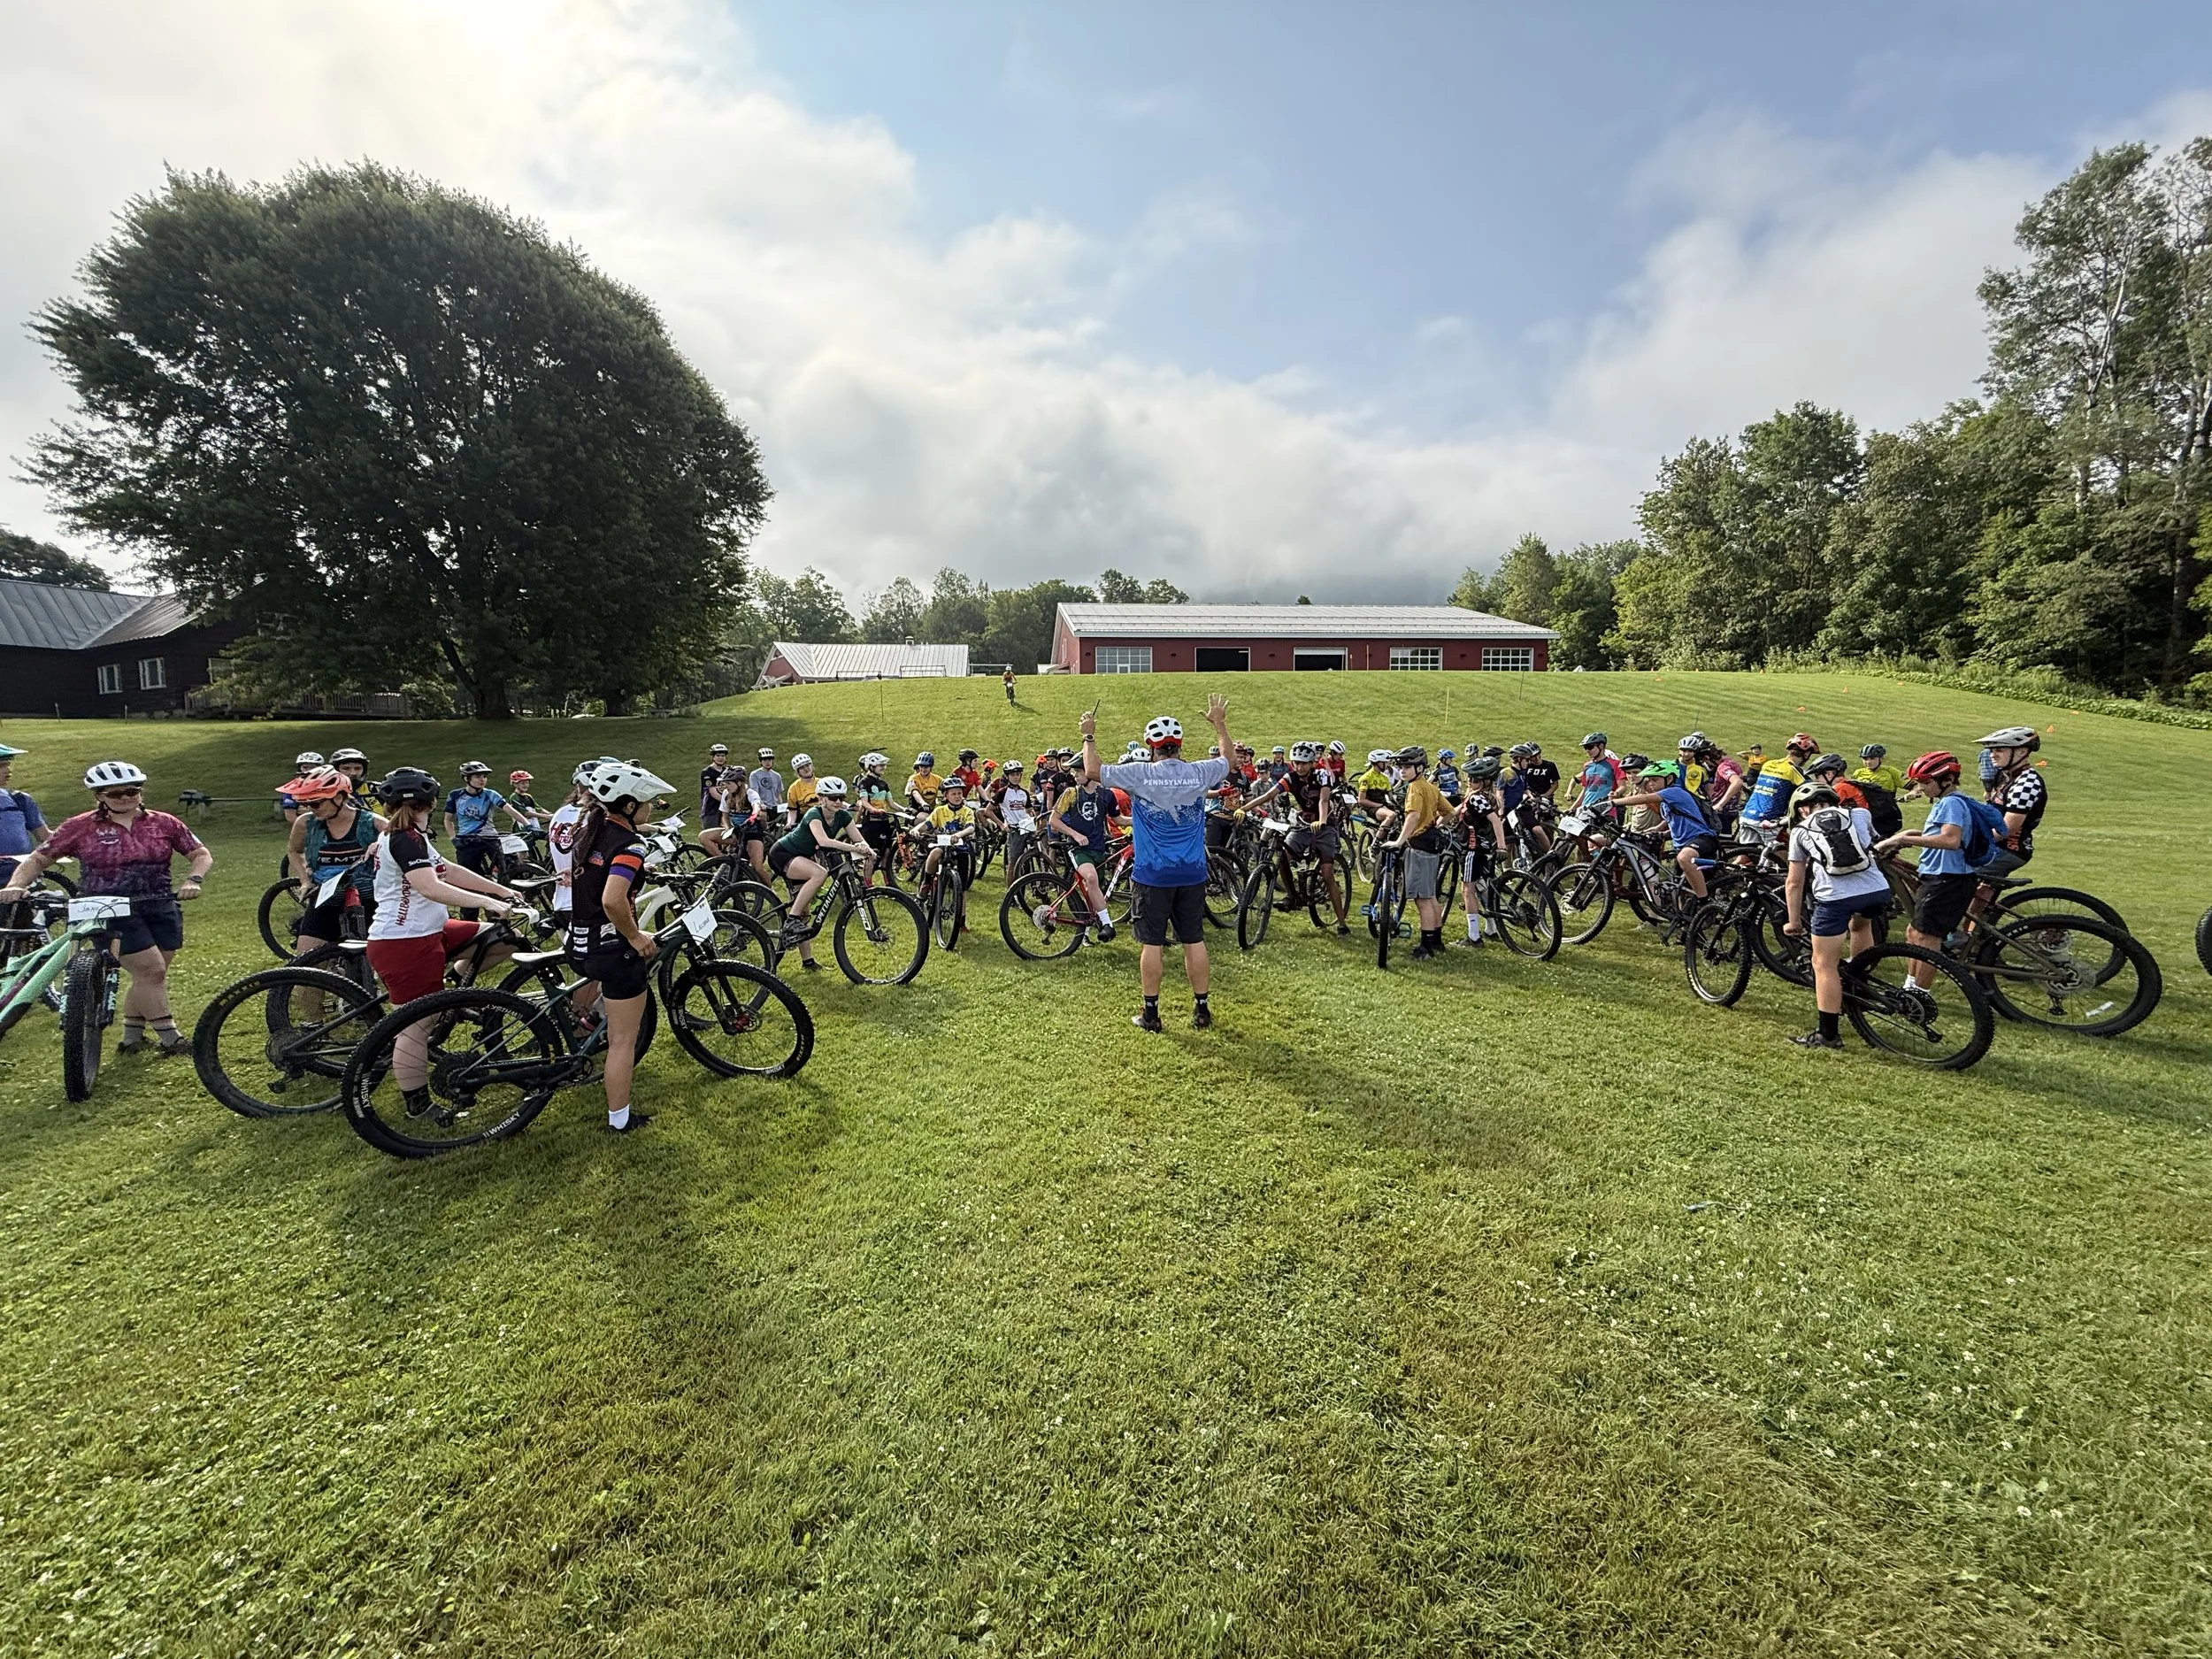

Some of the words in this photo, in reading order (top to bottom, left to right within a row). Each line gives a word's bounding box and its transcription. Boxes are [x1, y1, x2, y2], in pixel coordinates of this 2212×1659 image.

[1143, 778, 1204, 787] PENNSYLVANIA
[1526, 767, 1548, 776] FOX
[815, 879, 841, 925] SPECIALIZED
[360, 1076, 373, 1109] WHISKY
[488, 1110, 521, 1135] WHISKY
